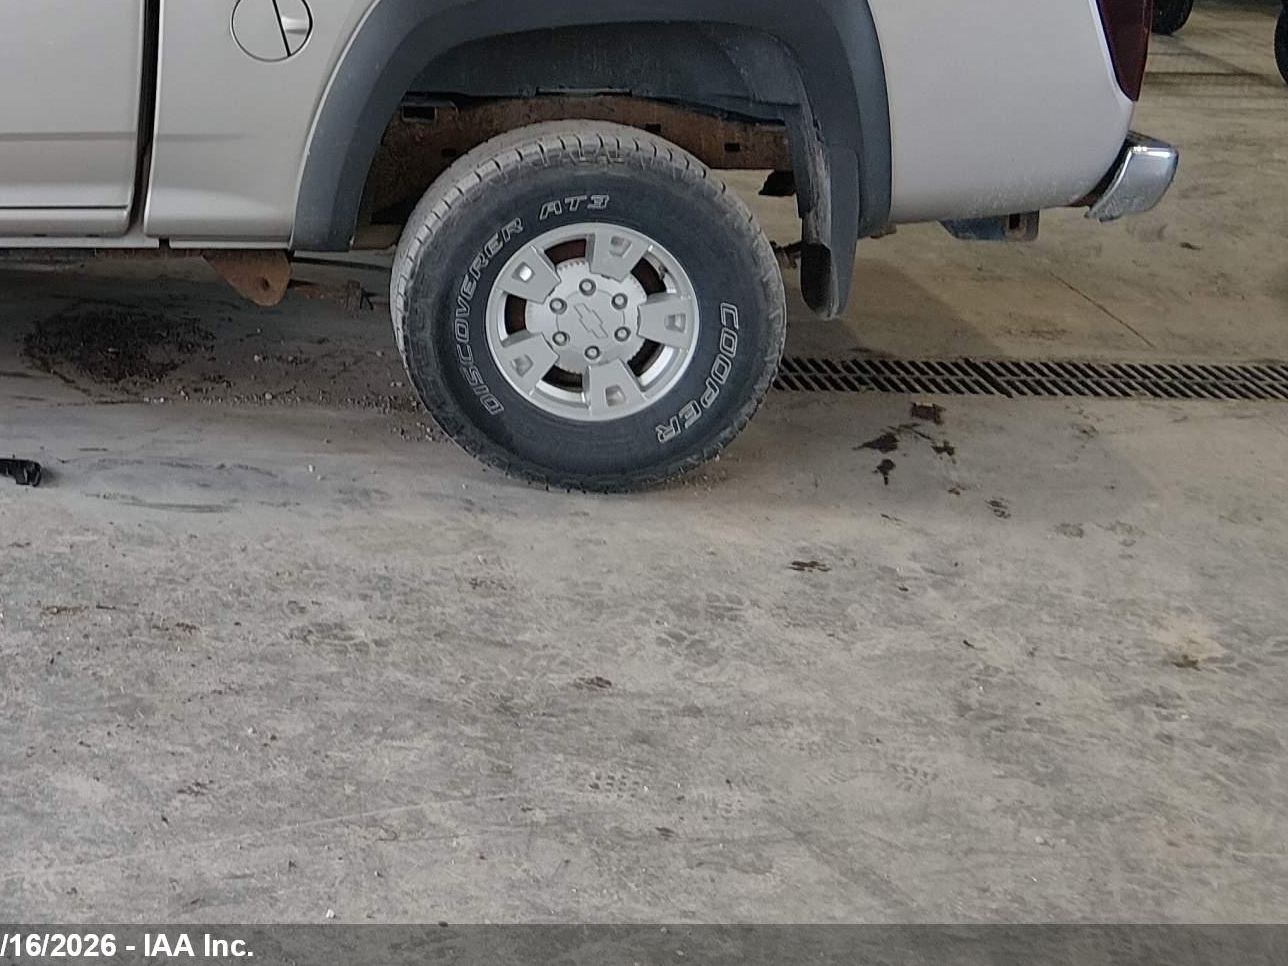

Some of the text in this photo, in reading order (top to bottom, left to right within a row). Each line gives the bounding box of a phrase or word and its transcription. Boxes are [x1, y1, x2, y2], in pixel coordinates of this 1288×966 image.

[453, 194, 610, 417] DISCOVERER AT3
[654, 301, 740, 444] COOPER
